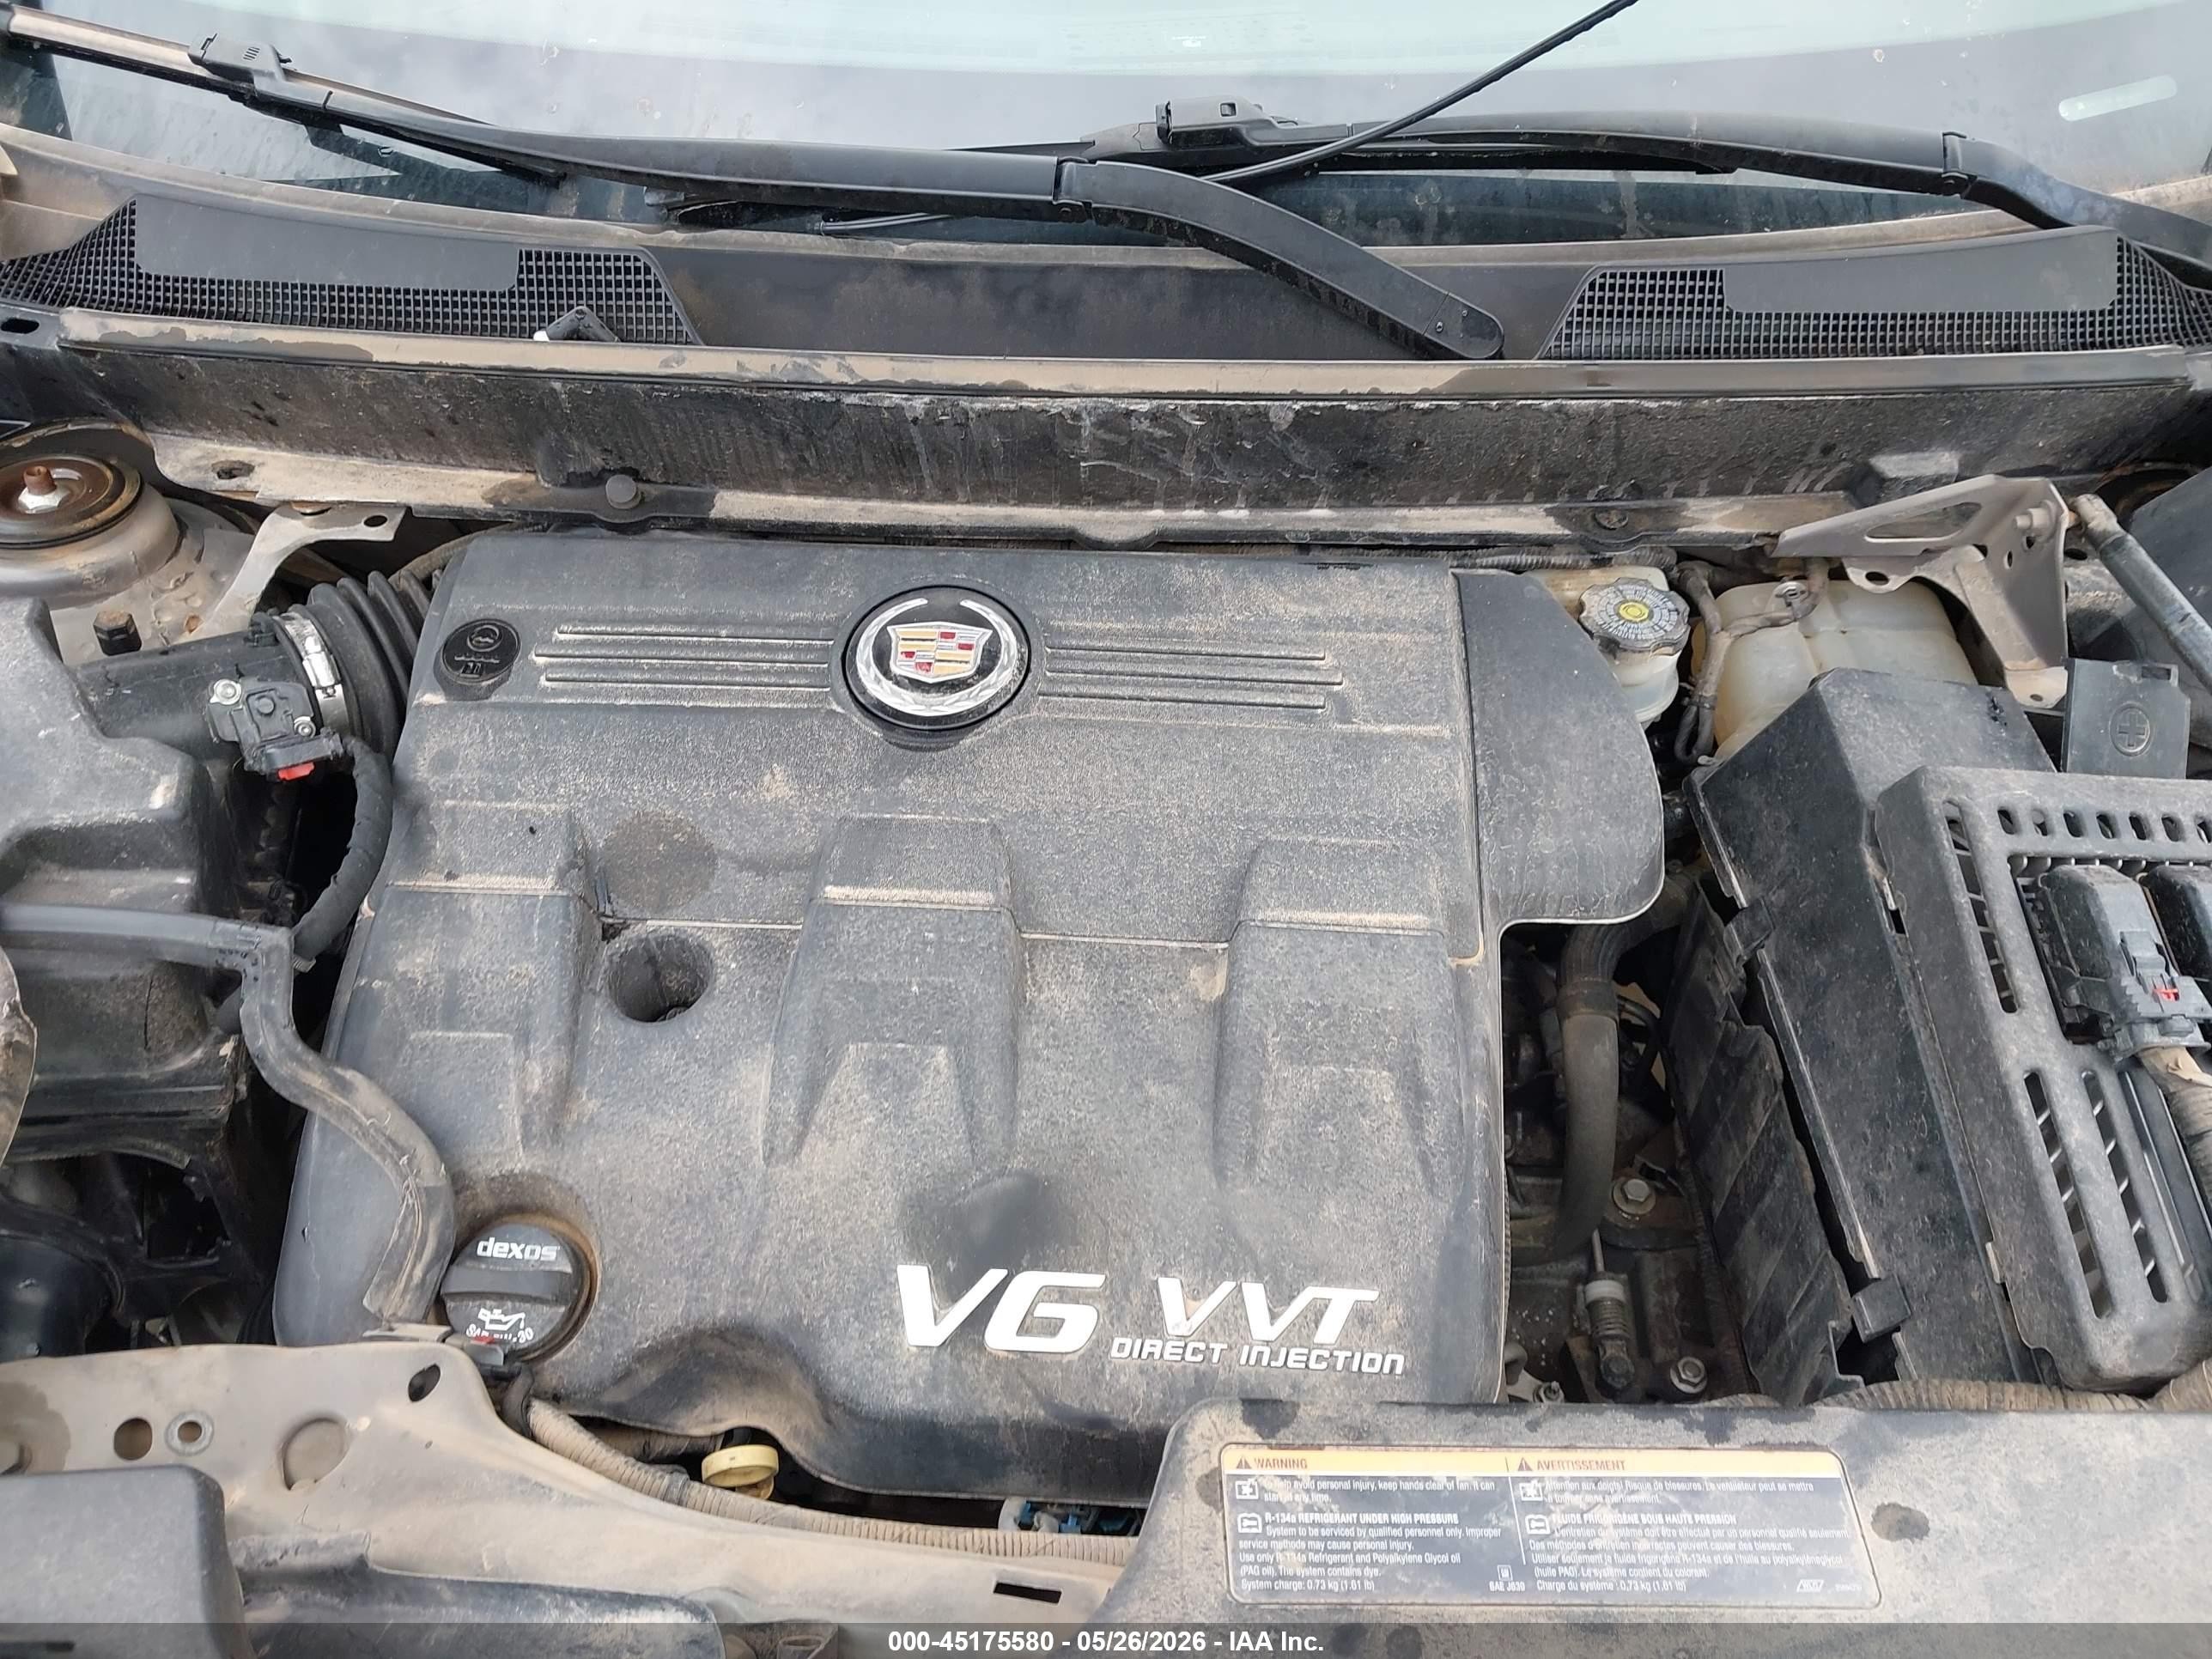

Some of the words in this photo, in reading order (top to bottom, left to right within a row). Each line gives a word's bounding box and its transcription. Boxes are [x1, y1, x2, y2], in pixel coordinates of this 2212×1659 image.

[477, 1237, 557, 1261] dexos
[896, 1264, 1106, 1352] V6
[1157, 1277, 1380, 1345] VVT
[1110, 1336, 1227, 1364] DIRECT
[1239, 1344, 1405, 1374] INJECTION
[1254, 1459, 1308, 1469] WARNING
[1537, 1460, 1626, 1470] AVERTISSEMENT
[1294, 1480, 1315, 1490] avoid
[1316, 1480, 1351, 1492] personal
[1352, 1480, 1376, 1492] injury,
[1378, 1480, 1397, 1492] keep
[1400, 1480, 1425, 1491] hands
[1425, 1480, 1444, 1491] clear
[1446, 1480, 1455, 1491] of
[1480, 1480, 1495, 1491] can
[1581, 1480, 1596, 1491] aux
[1625, 1480, 1651, 1492] Risque
[1653, 1480, 1664, 1491] de
[1717, 1481, 1756, 1492] ventilateur
[1758, 1481, 1777, 1493] peut
[1778, 1481, 1787, 1492] se
[1789, 1481, 1814, 1492] mettre
[1311, 1493, 1331, 1503] time.
[1265, 1513, 1297, 1523] R-134a
[1297, 1513, 1358, 1523] REFRIGERANT
[1359, 1514, 1389, 1524] UNDER
[1390, 1514, 1412, 1524] HIGH
[1413, 1514, 1458, 1524] PRESSURE
[1640, 1513, 1664, 1525] SOUS
[1665, 1513, 1692, 1525] HAUTE
[1693, 1513, 1737, 1525] PRESSION
[1267, 1527, 1297, 1538] System
[1297, 1527, 1306, 1536] to
[1309, 1527, 1319, 1536] be
[1321, 1527, 1355, 1536] serviced
[1356, 1527, 1366, 1538] by
[1368, 1528, 1402, 1539] qualified
[1404, 1528, 1443, 1539] personnel
[1445, 1528, 1464, 1539] only.
[1465, 1528, 1500, 1539] Improper
[1608, 1527, 1643, 1539] ystème
[1712, 1528, 1725, 1540] par
[1727, 1528, 1738, 1538] un
[1738, 1528, 1777, 1540] personnel
[1238, 1540, 1268, 1550] service
[1270, 1540, 1306, 1550] methods
[1307, 1540, 1325, 1552] may
[1327, 1540, 1351, 1550] cause
[1352, 1540, 1388, 1552] personal
[1389, 1540, 1414, 1552] injury.
[1529, 1540, 1545, 1550] Des
[1239, 1553, 1255, 1563] Use
[1256, 1553, 1274, 1565] only
[1308, 1553, 1353, 1565] Refrigerant
[1355, 1553, 1371, 1563] and
[1372, 1553, 1422, 1565] Polyalkylene
[1424, 1553, 1449, 1565] Glycol
[1450, 1553, 1461, 1563] oil
[1613, 1553, 1637, 1564] fluide
[1713, 1554, 1723, 1565] et
[1723, 1554, 1734, 1565] de
[1241, 1565, 1261, 1577] (PAG
[1279, 1565, 1295, 1576] The
[1296, 1565, 1326, 1577] system
[1328, 1566, 1362, 1577] contains
[1364, 1566, 1382, 1578] dye.
[1534, 1566, 1557, 1578] (huile
[1558, 1566, 1580, 1578] PAG).
[1581, 1566, 1592, 1577] Le
[1662, 1567, 1674, 1577] du
[1241, 1579, 1272, 1591] System
[1273, 1579, 1305, 1591] charge:
[1307, 1580, 1327, 1590] 0.73
[1328, 1580, 1340, 1592] kg
[1364, 1580, 1374, 1592] lb)
[1488, 1580, 1505, 1590] SAE
[1536, 1579, 1566, 1592] Charge
[1567, 1579, 1579, 1590] du
[1640, 1579, 1651, 1592] kg
